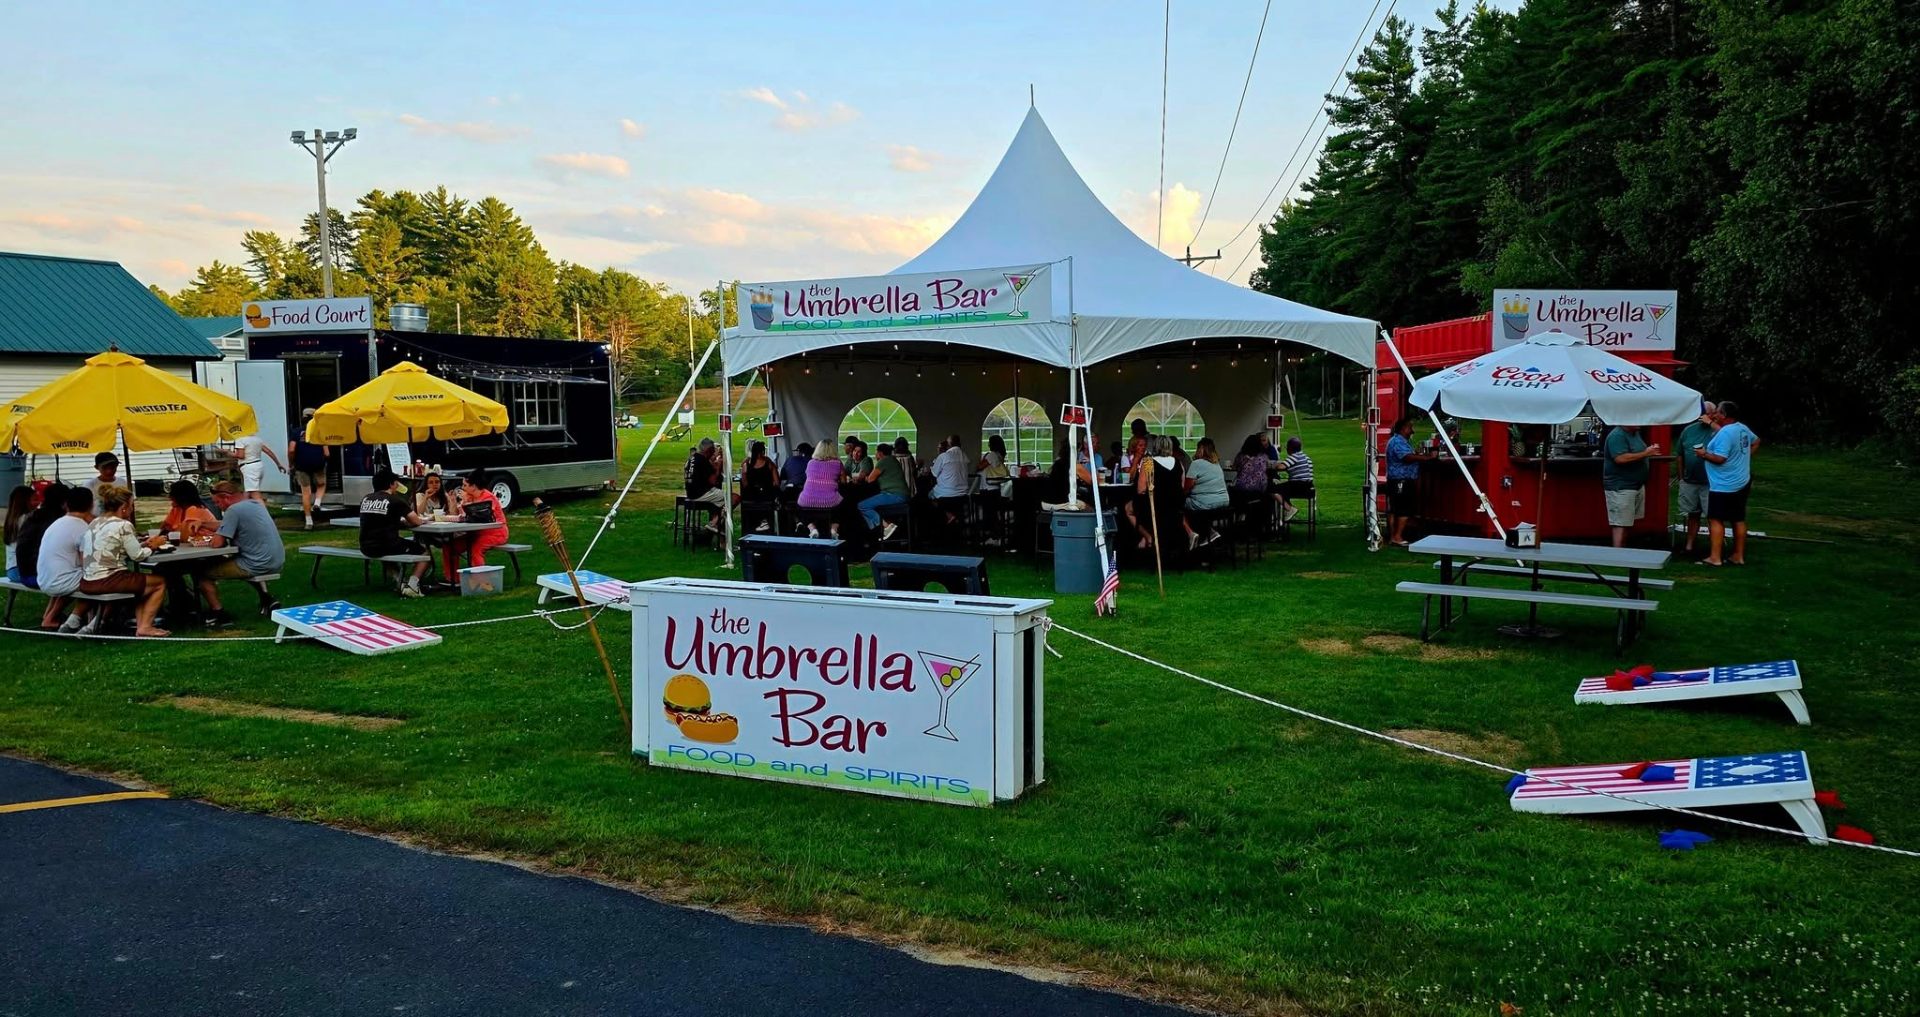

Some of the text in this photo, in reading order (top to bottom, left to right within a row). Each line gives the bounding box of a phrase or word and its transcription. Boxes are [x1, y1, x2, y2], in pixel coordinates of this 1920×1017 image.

[784, 278, 998, 318] Umbrella Bar
[809, 284, 831, 296] the
[1558, 294, 1577, 305] the
[271, 304, 368, 325] Food Court
[781, 310, 988, 331] FOOD and SPIRITS
[1536, 298, 1645, 323] Umbrella
[1581, 322, 1633, 346] Bar
[1491, 365, 1565, 383] Coors
[1492, 379, 1552, 390] LIGHT
[1585, 368, 1653, 385] Coors
[1606, 382, 1657, 391] LIGHT
[125, 404, 167, 414] TWISTED
[166, 403, 188, 411] TEA
[709, 607, 750, 635] the
[663, 615, 916, 693] Umbrella
[763, 687, 888, 754] Bar
[668, 744, 971, 794] FOOD and SPIRITS
